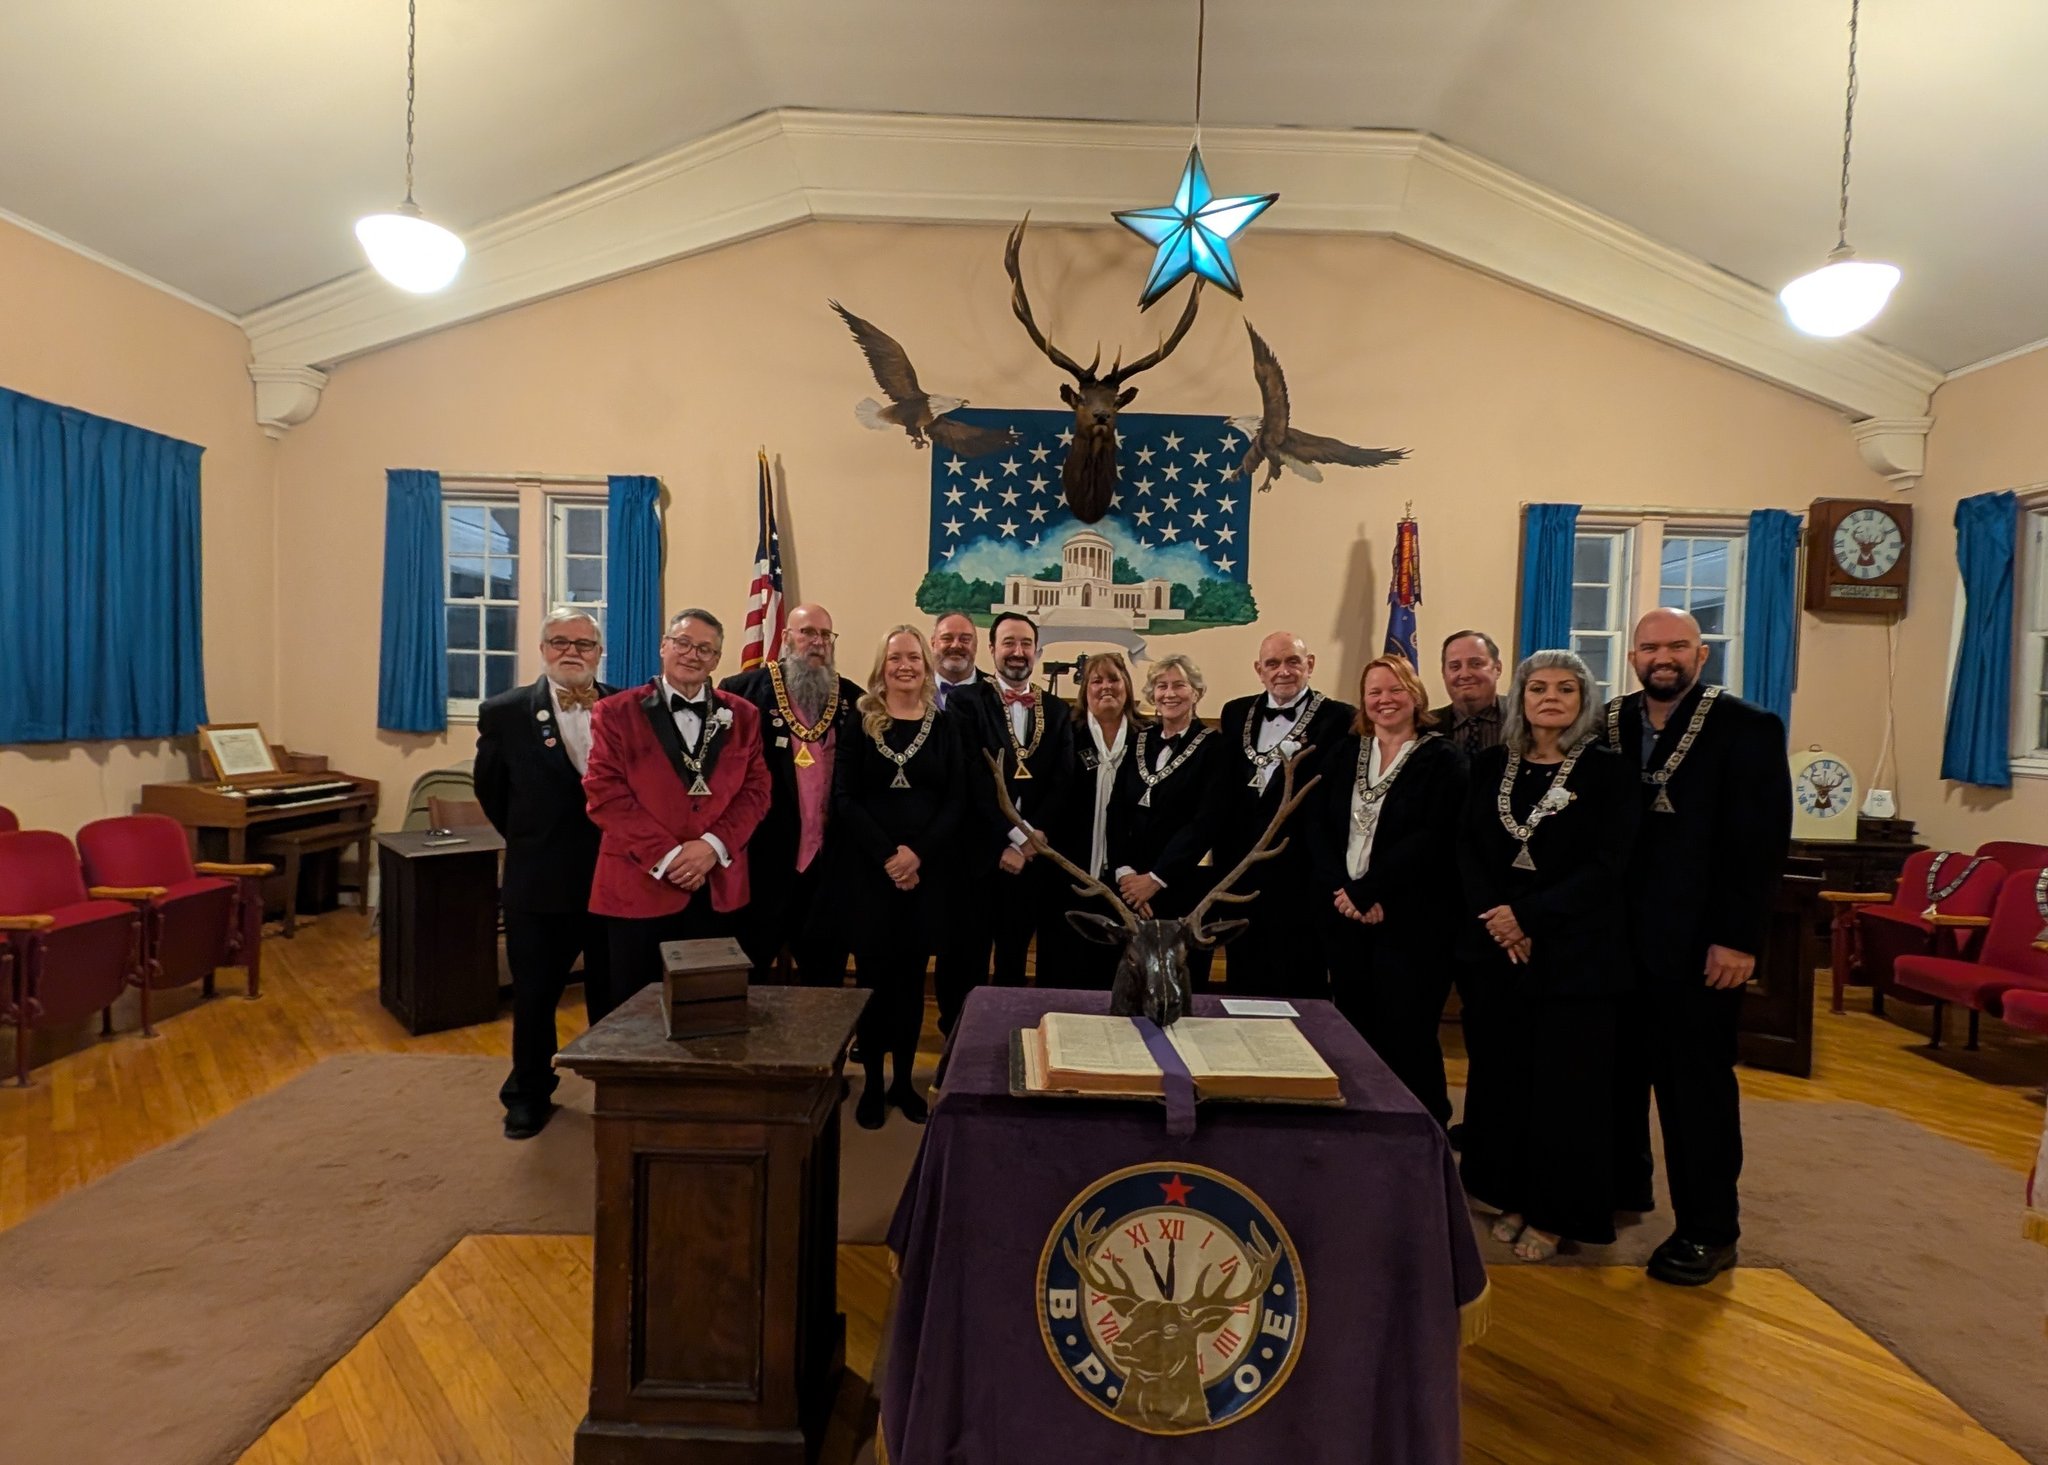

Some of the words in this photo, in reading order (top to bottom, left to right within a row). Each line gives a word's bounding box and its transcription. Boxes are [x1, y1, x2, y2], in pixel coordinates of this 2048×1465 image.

[1125, 1222, 1150, 1249] XI
[1158, 1218, 1185, 1241] XII
[1199, 1231, 1215, 1250] I
[1212, 1327, 1242, 1359] IIII
